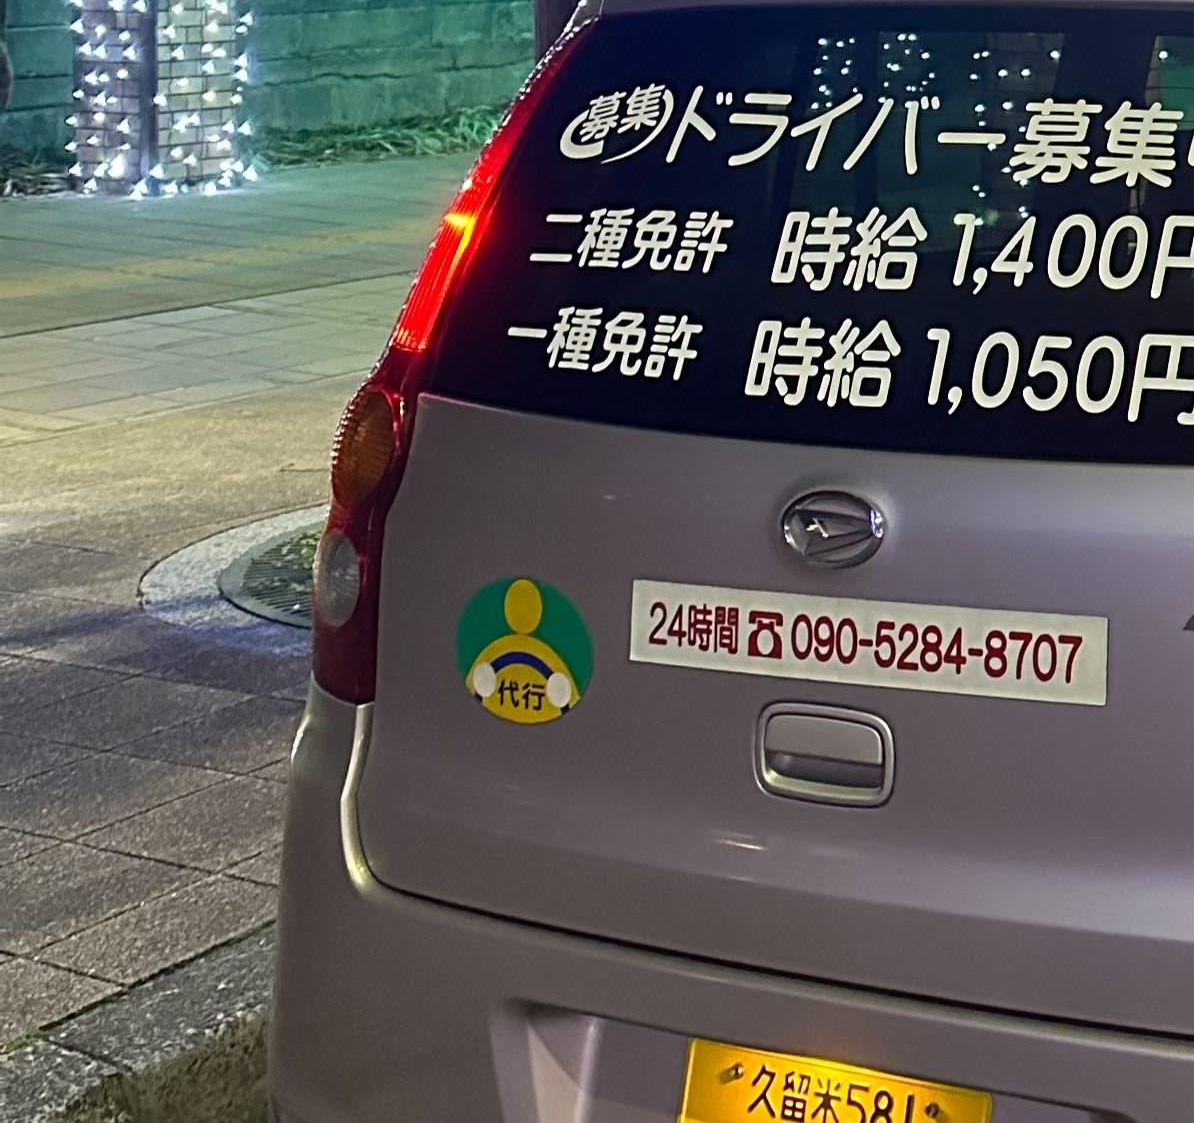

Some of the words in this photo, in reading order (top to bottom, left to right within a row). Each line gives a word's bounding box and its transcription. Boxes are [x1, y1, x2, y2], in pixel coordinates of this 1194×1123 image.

[529, 207, 734, 274] 二種免許
[507, 306, 703, 381] 一種免許
[648, 602, 739, 655] 24時間
[791, 613, 1083, 684] 090-5284-8707
[497, 679, 545, 711] 代行
